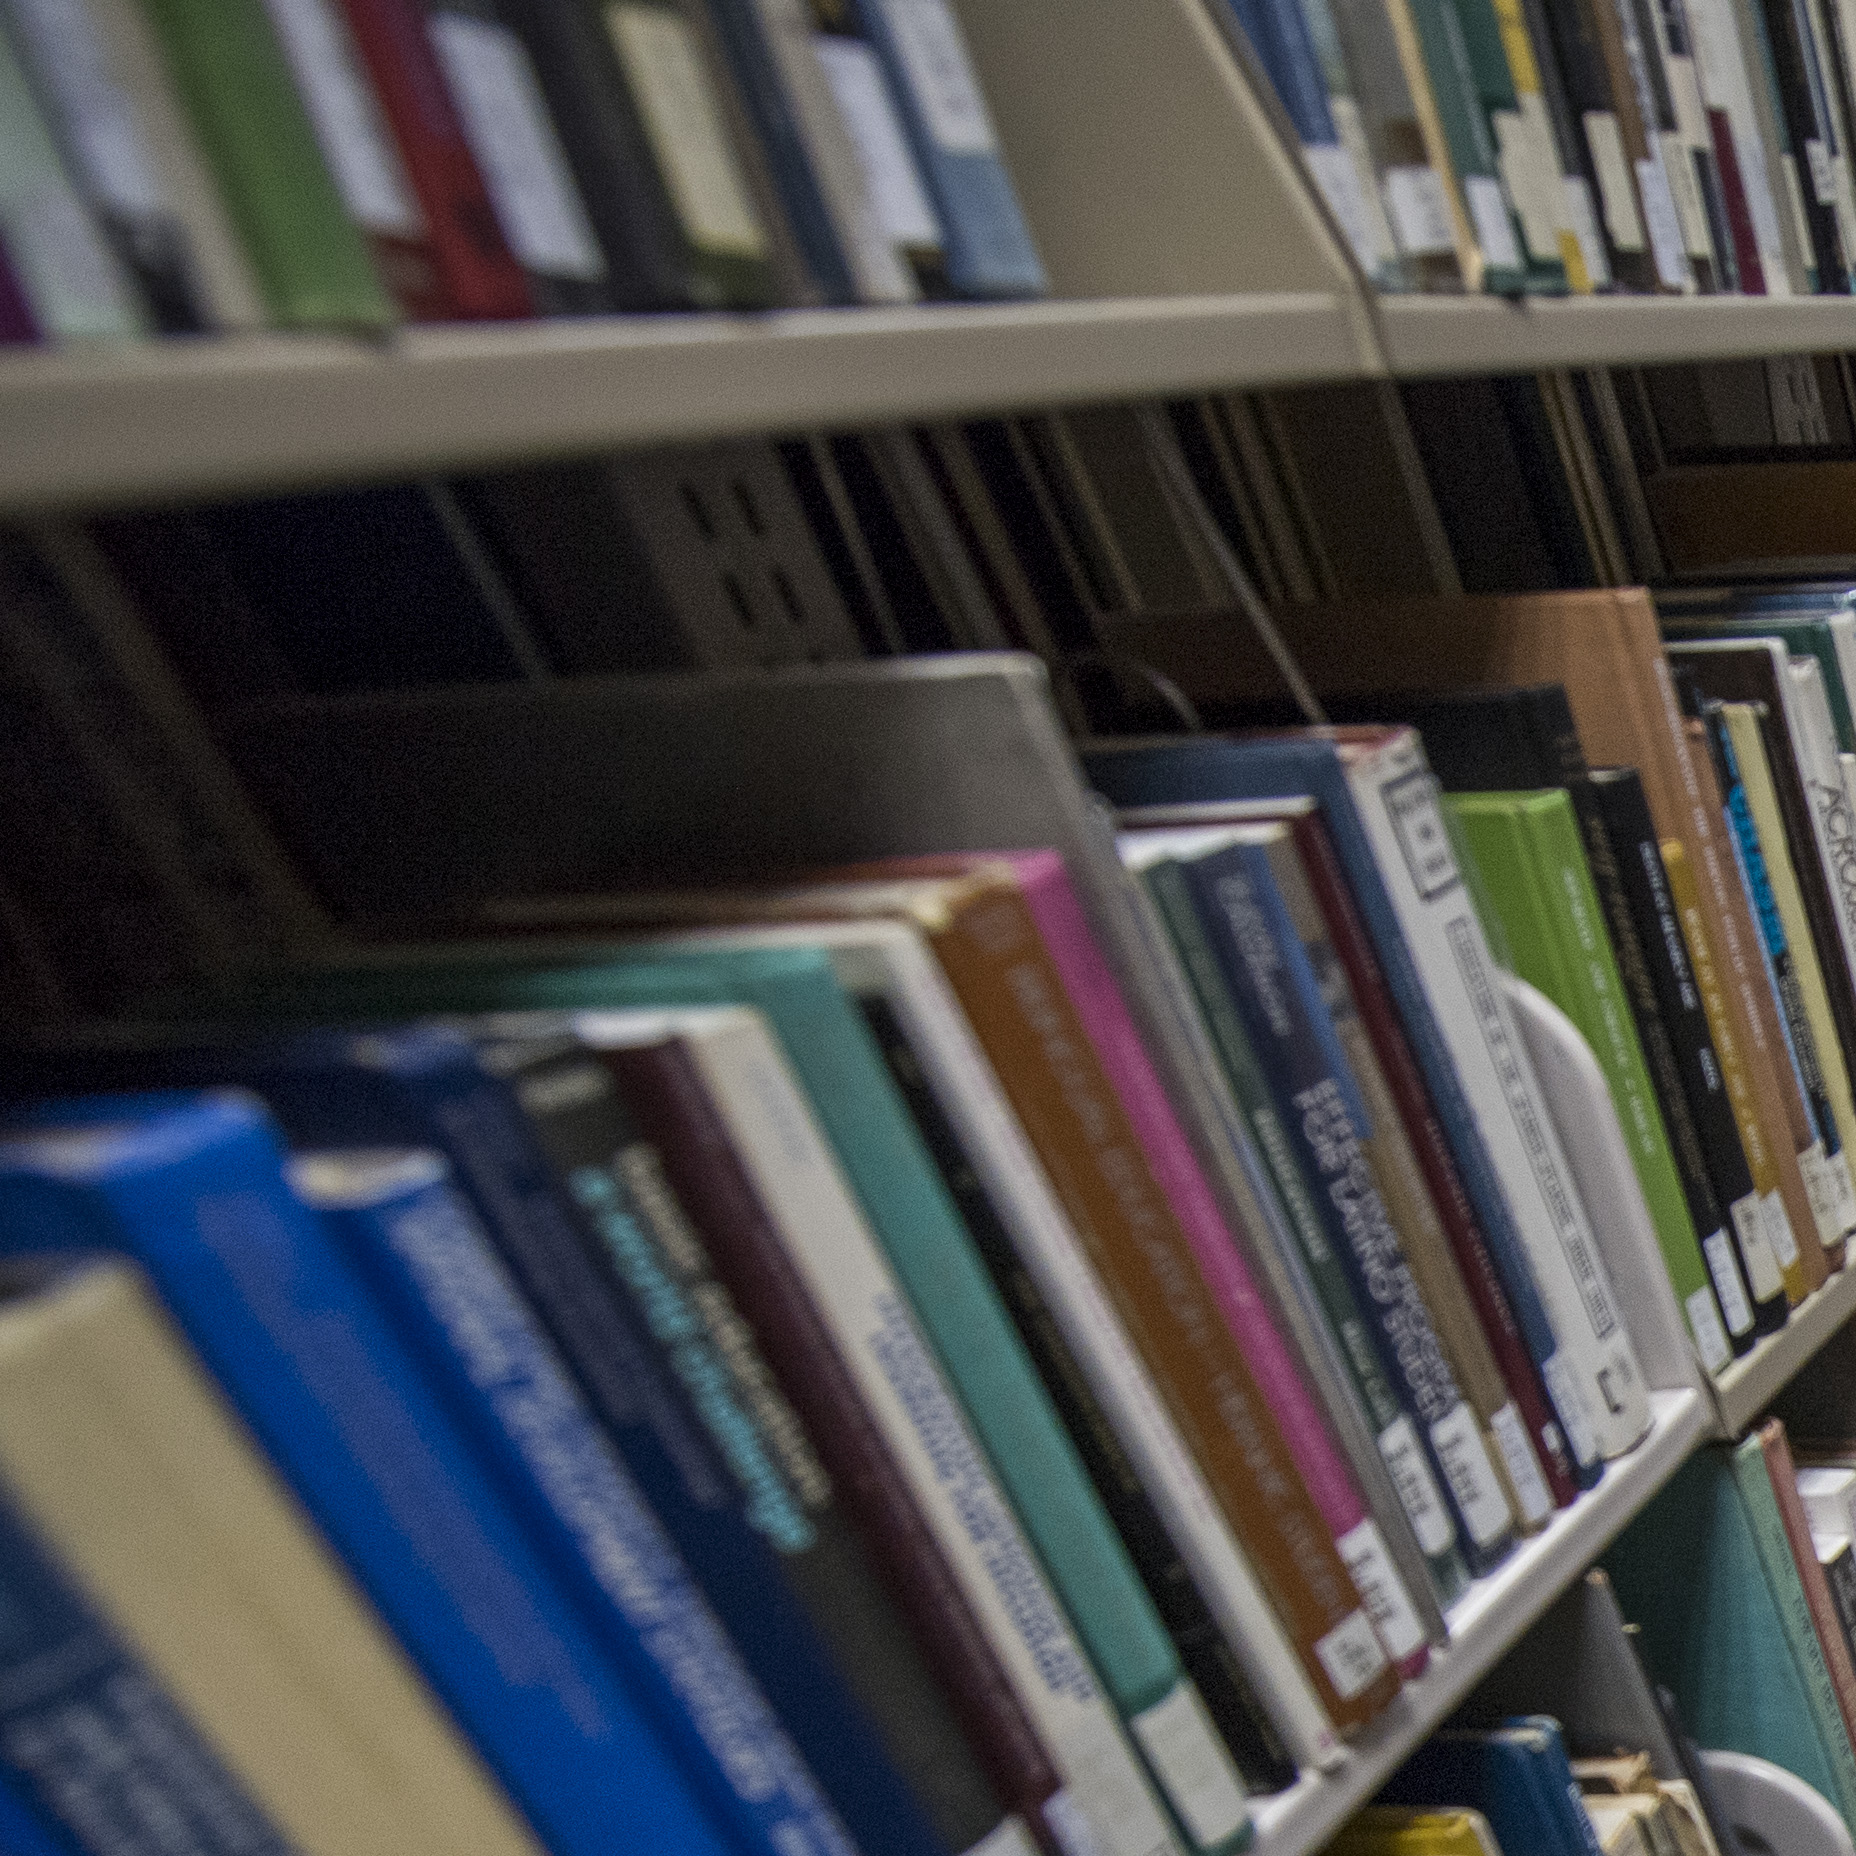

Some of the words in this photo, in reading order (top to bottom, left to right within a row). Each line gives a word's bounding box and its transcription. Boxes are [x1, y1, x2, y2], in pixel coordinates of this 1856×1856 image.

[1289, 1086, 1346, 1176] FOR
[1326, 1175, 1399, 1307] LATINO
[1379, 1305, 1447, 1424] STUDEN
[1386, 1262, 1466, 1412] PROGRA
